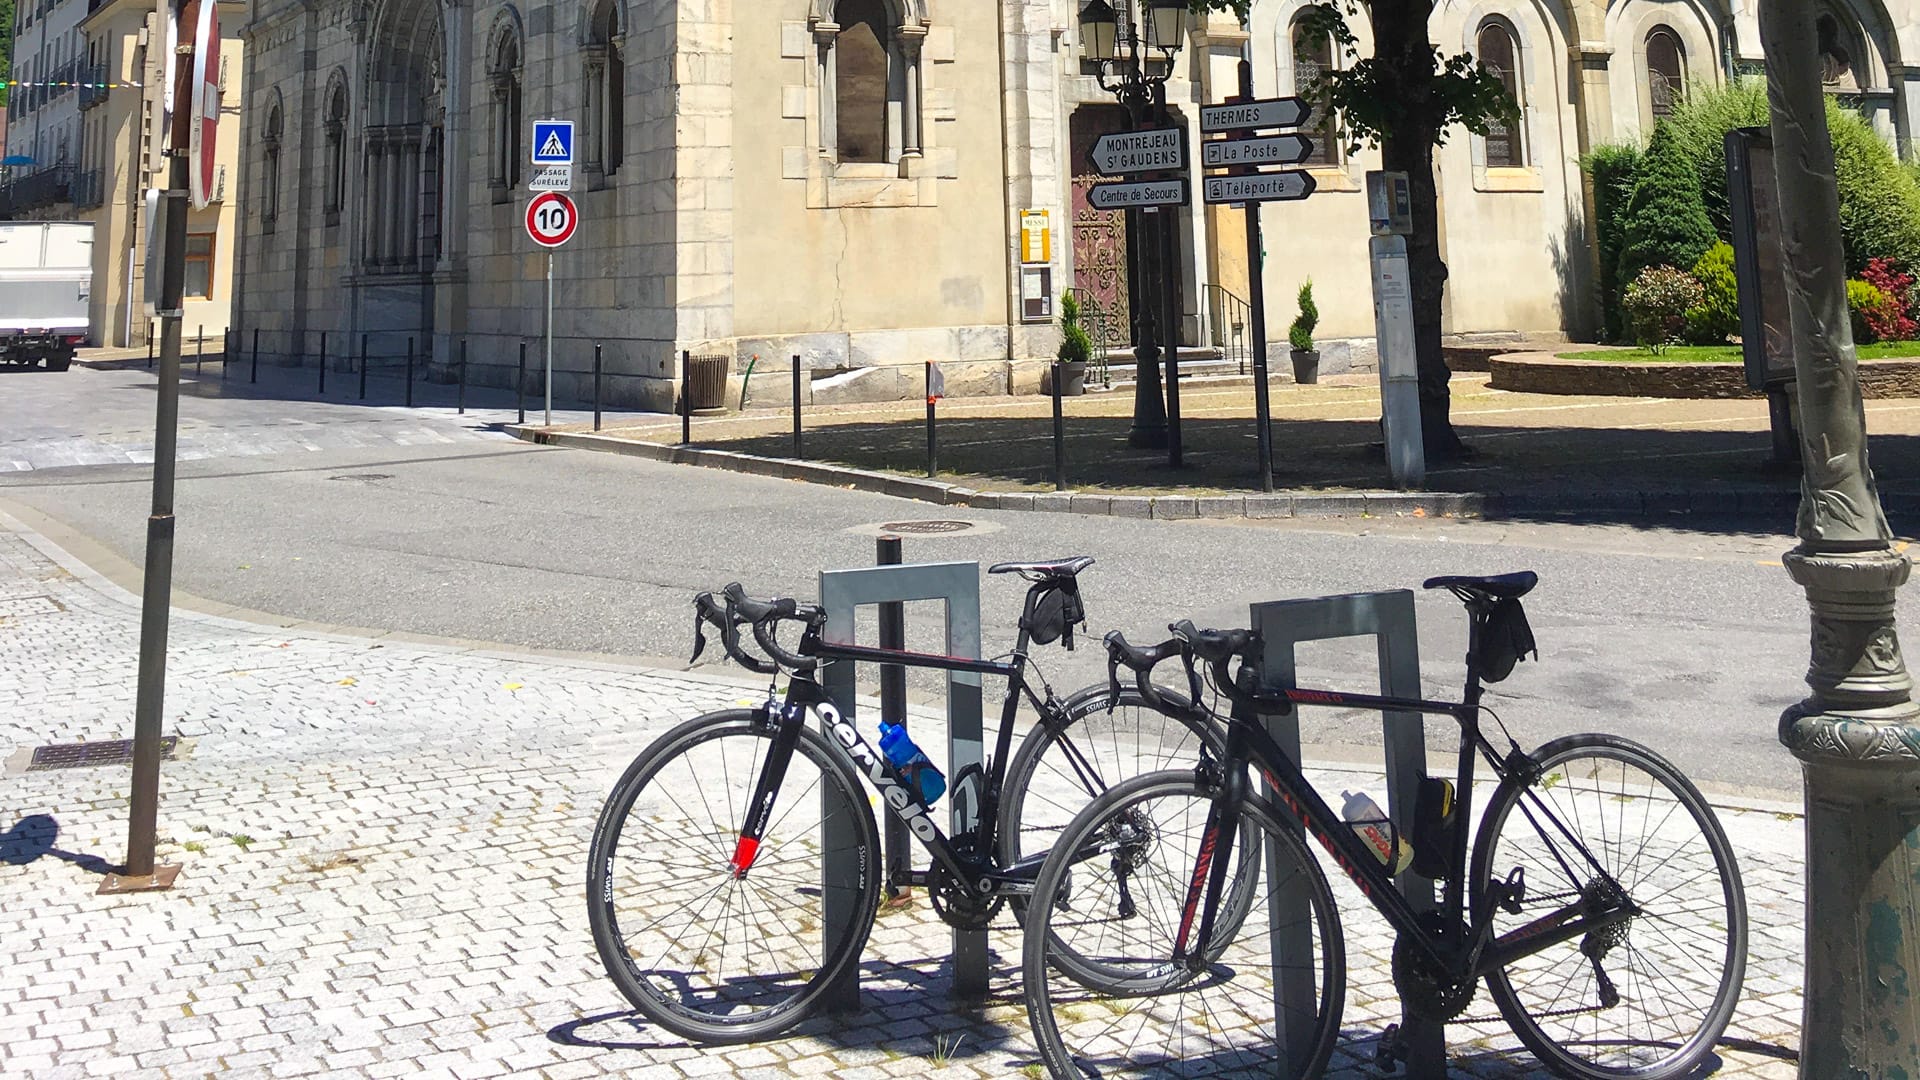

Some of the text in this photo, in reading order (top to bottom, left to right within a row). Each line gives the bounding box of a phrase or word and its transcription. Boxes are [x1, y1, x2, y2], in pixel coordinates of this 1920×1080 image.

[1206, 108, 1260, 126] THERMES
[1106, 134, 1177, 153] MONTRÉJEAU
[1224, 143, 1278, 160] La Poste
[1121, 150, 1177, 167] GAUDENS
[532, 178, 569, 186] SURÉLEVÉ
[1226, 180, 1285, 197] Téléporté
[1100, 187, 1178, 203] Centre de Secours
[538, 208, 565, 230] 10
[1085, 700, 1107, 714] SWISS
[604, 875, 612, 903] SWISS
[1160, 962, 1175, 975] SWI
